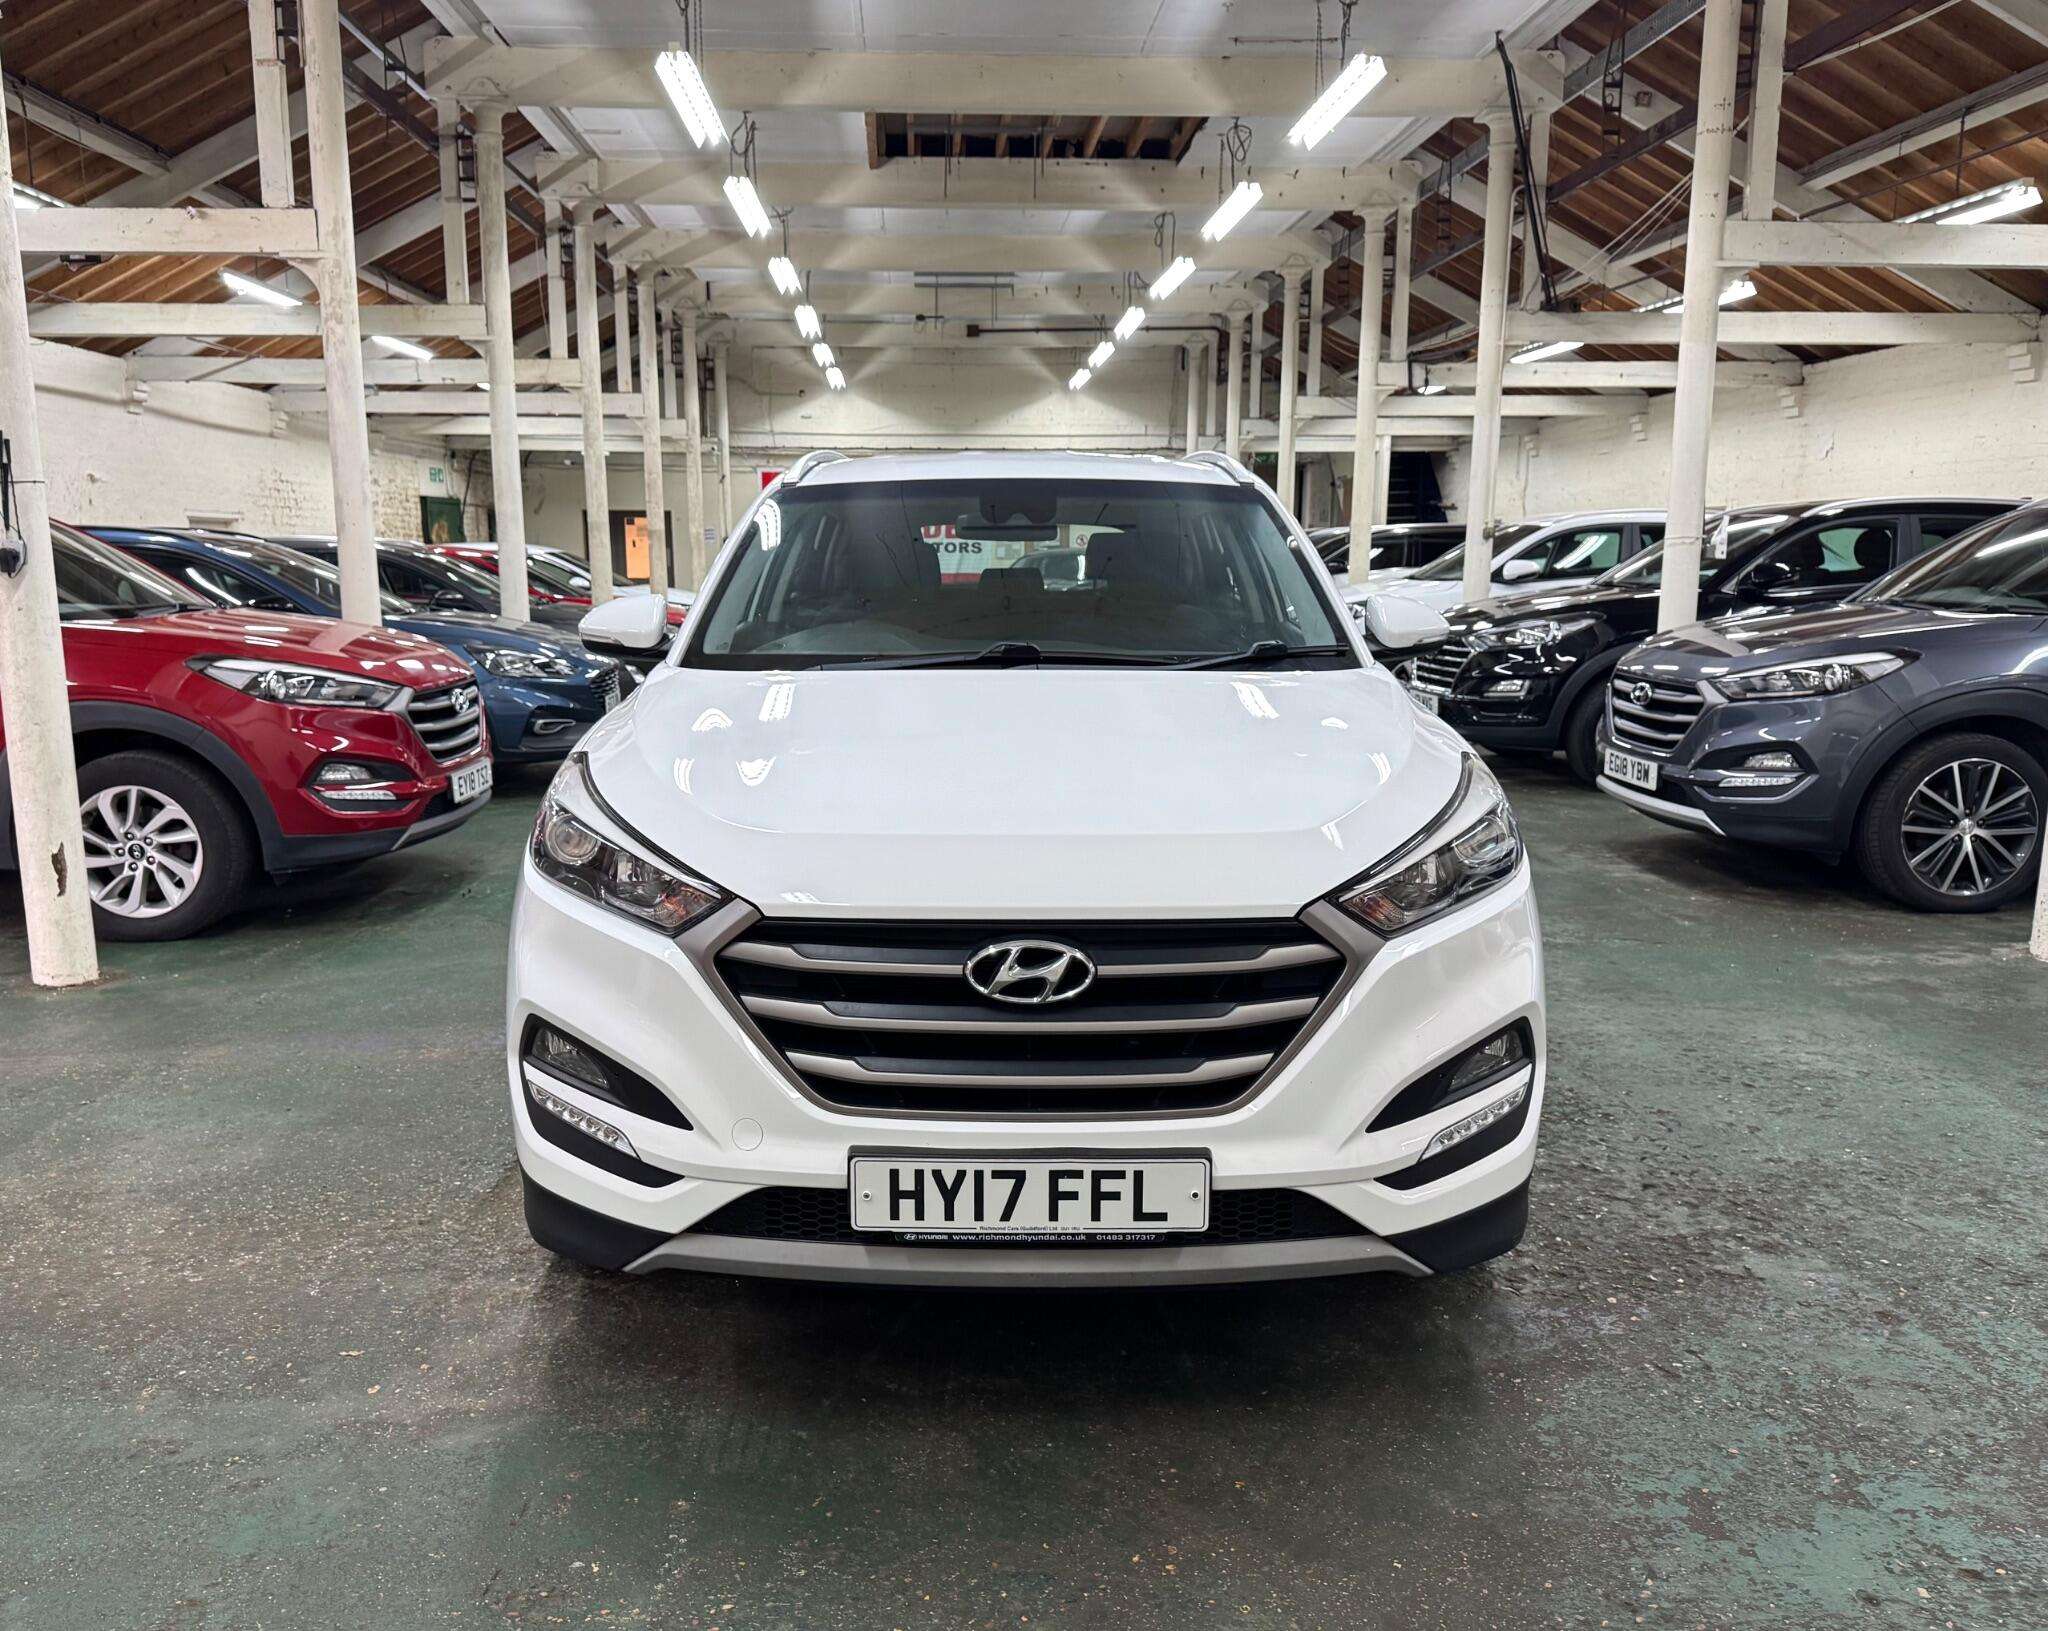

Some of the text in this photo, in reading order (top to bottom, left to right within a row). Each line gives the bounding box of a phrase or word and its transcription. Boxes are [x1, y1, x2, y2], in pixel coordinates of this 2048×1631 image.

[1609, 752, 1628, 776] EG18
[889, 1168, 1168, 1222] HY17 FFL
[953, 1233, 1087, 1242] www.richmondhyundai.co.uk
